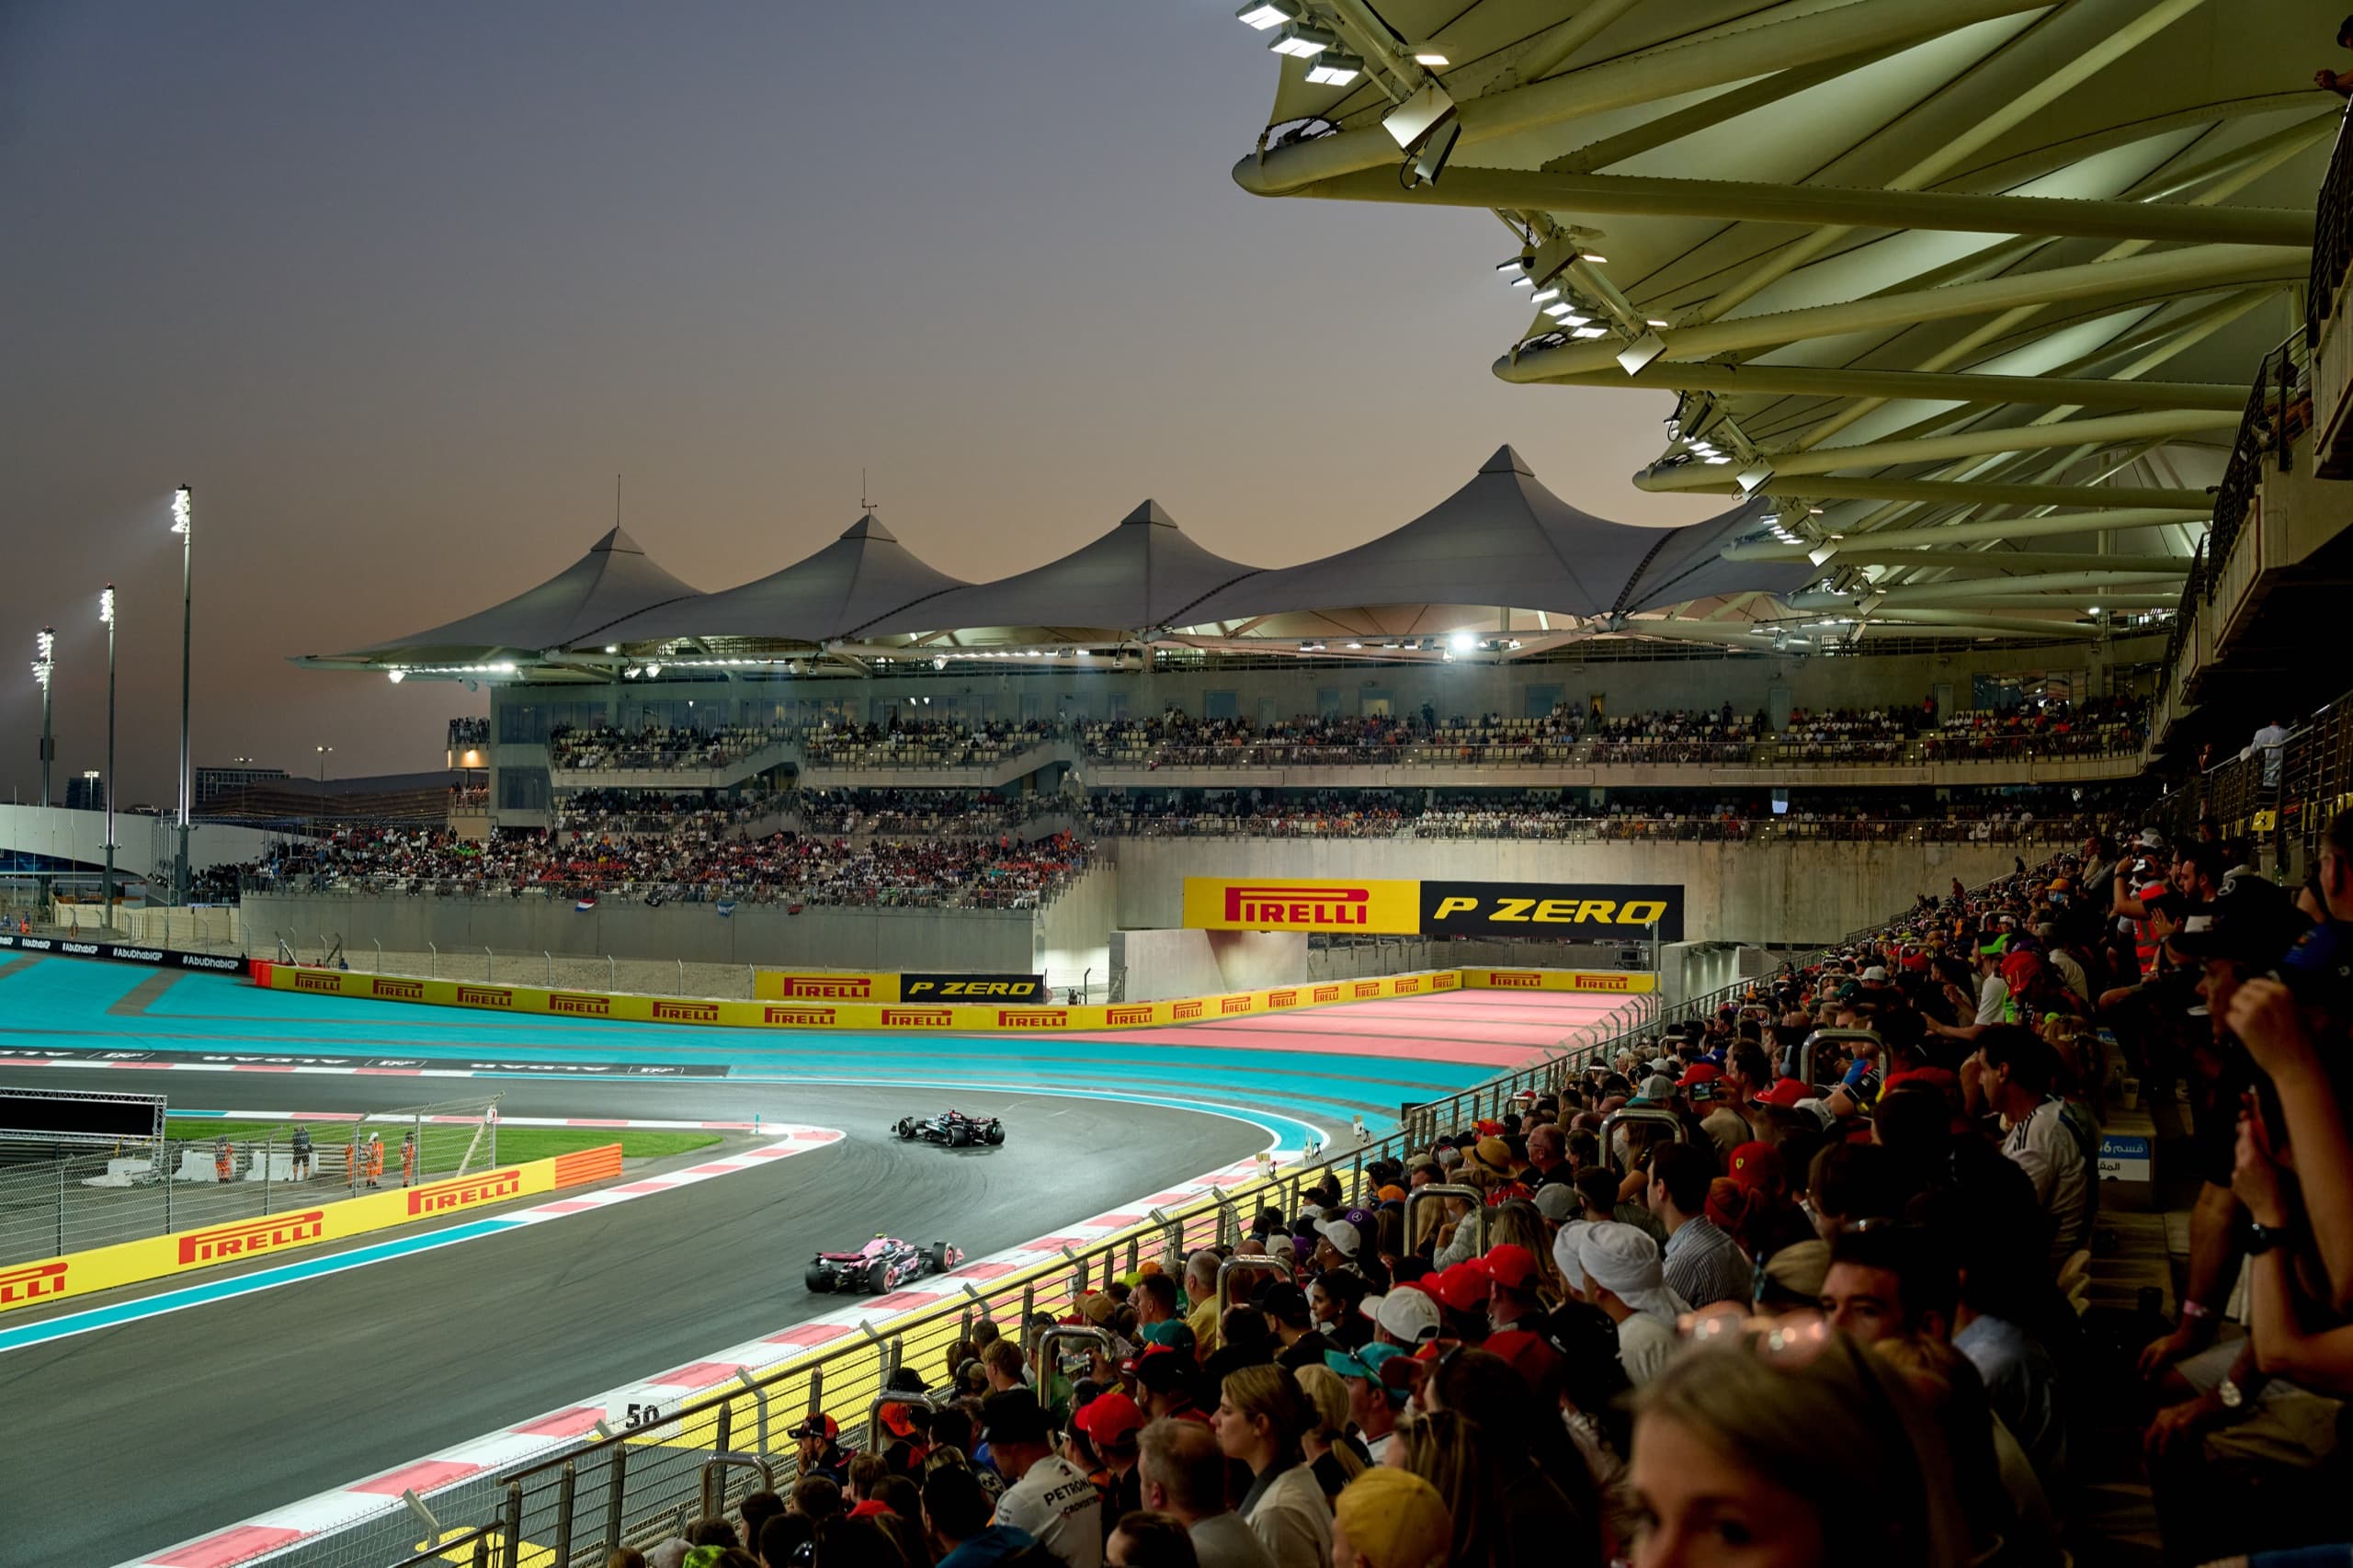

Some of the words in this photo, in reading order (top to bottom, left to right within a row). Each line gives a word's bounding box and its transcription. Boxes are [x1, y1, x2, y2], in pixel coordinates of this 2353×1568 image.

[1224, 887, 1370, 925] PIRELLI
[1433, 897, 1479, 920] P
[1488, 899, 1667, 925] ZERO
[113, 948, 163, 961] #AbuDhabiGP
[183, 955, 239, 970] #AbuDhabiGP
[295, 972, 341, 992] PIRELLI
[784, 977, 871, 998] PIRELLI
[1394, 978, 1419, 994] PIRELLI
[1433, 974, 1454, 989] PIRELLI
[1490, 972, 1541, 986] PIRELLI
[1575, 975, 1629, 990] PIRELLI
[372, 979, 424, 998] PIRELLI
[457, 986, 513, 1006] PIRELLI
[908, 983, 934, 994] P
[939, 983, 1036, 996] ZERO
[1313, 986, 1339, 1003] PIRELLI
[1355, 983, 1380, 998] PIRELLI
[549, 994, 610, 1014] PIRELLI
[1222, 996, 1251, 1014] PIRELLI
[1268, 991, 1297, 1008] PIRELLI
[653, 1001, 719, 1021] PIRELLI
[764, 1007, 836, 1025] PIRELLI
[881, 1009, 953, 1027] PIRELLI
[998, 1011, 1067, 1027] PIRELLI
[1107, 1007, 1153, 1025] PIRELLI
[1173, 1002, 1202, 1019] PIRELLI
[202, 1055, 350, 1064] ALDAR
[408, 1170, 520, 1215] PIRELLI
[178, 1210, 324, 1265] PIRELLI
[625, 1403, 660, 1428] 50
